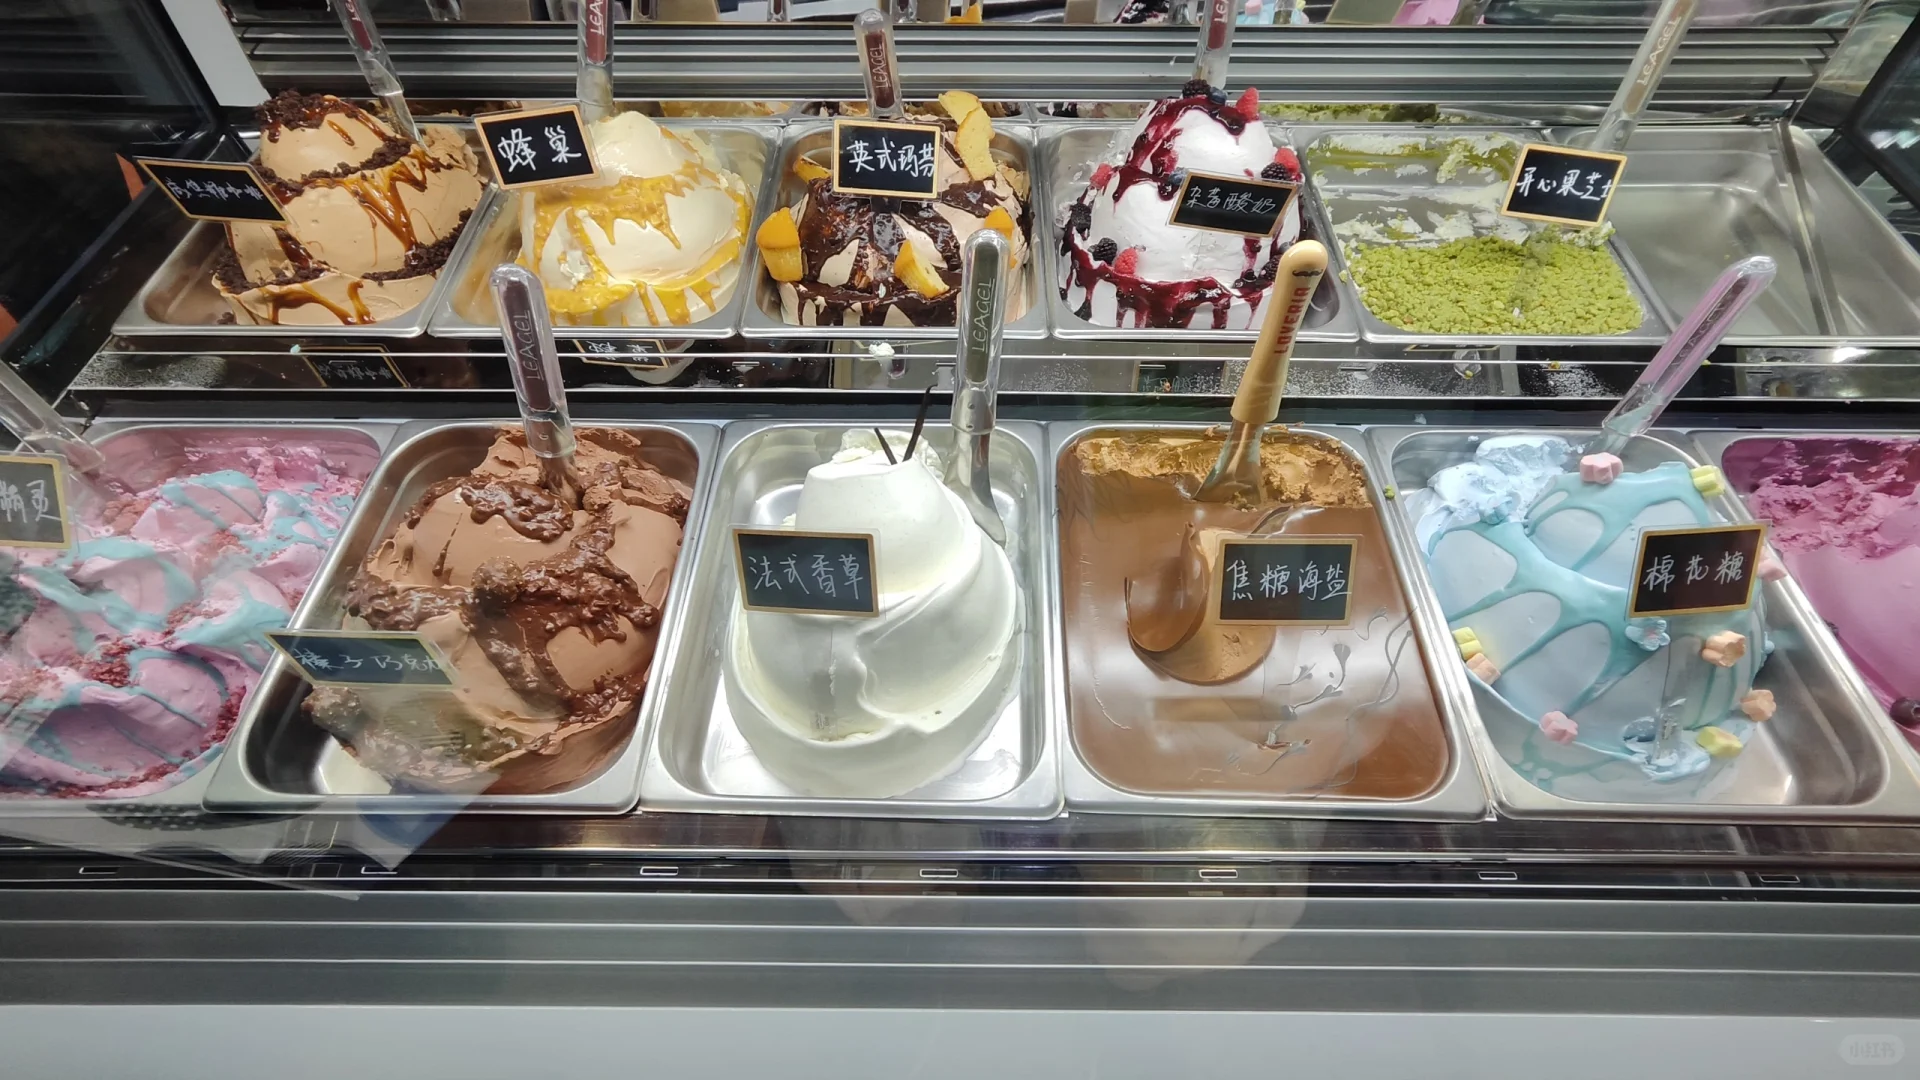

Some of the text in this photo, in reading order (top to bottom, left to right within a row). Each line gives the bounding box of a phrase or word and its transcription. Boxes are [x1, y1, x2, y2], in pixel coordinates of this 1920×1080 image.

[869, 43, 891, 88] LEAGEL
[1636, 16, 1681, 86] LEAGEL
[497, 125, 582, 172] 蜂巢
[846, 137, 935, 177] 英式玛芬
[1187, 185, 1276, 214] 杂莓酸奶
[1516, 167, 1612, 200] 开心果芝士
[971, 278, 995, 354] LEAGEL
[1274, 287, 1311, 355] LOVERIA
[513, 310, 544, 380] LEAGEL
[748, 553, 863, 600] 法式香草
[1226, 559, 1352, 601] 焦糖海盐
[1643, 551, 1744, 593] 棉花糖
